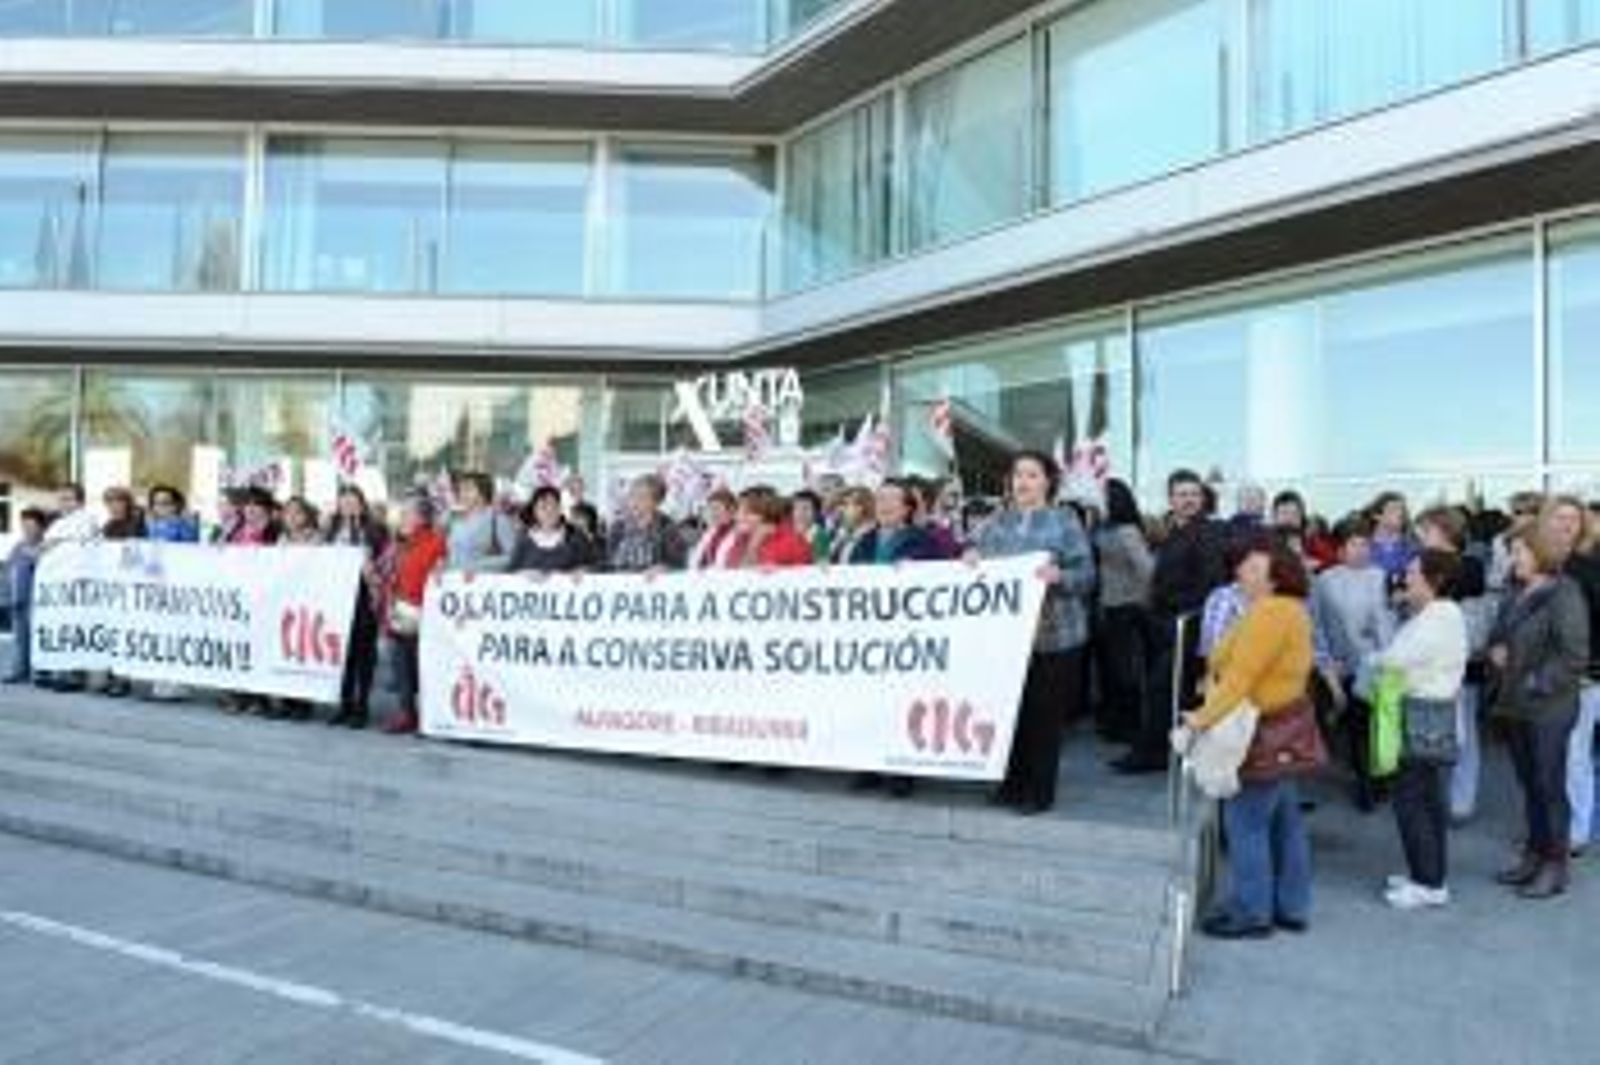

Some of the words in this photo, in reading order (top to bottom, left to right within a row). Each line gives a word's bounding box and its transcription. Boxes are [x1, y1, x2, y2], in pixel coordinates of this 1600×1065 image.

[669, 367, 803, 452] XUNTA
[609, 592, 691, 622] PARA
[698, 593, 719, 621] A
[728, 574, 1022, 621] CONSTRUCCIÓN
[477, 632, 552, 666] PARA
[558, 635, 578, 666] A
[585, 636, 753, 672] CONSERVA
[764, 631, 950, 674] SOLUCIÓN
